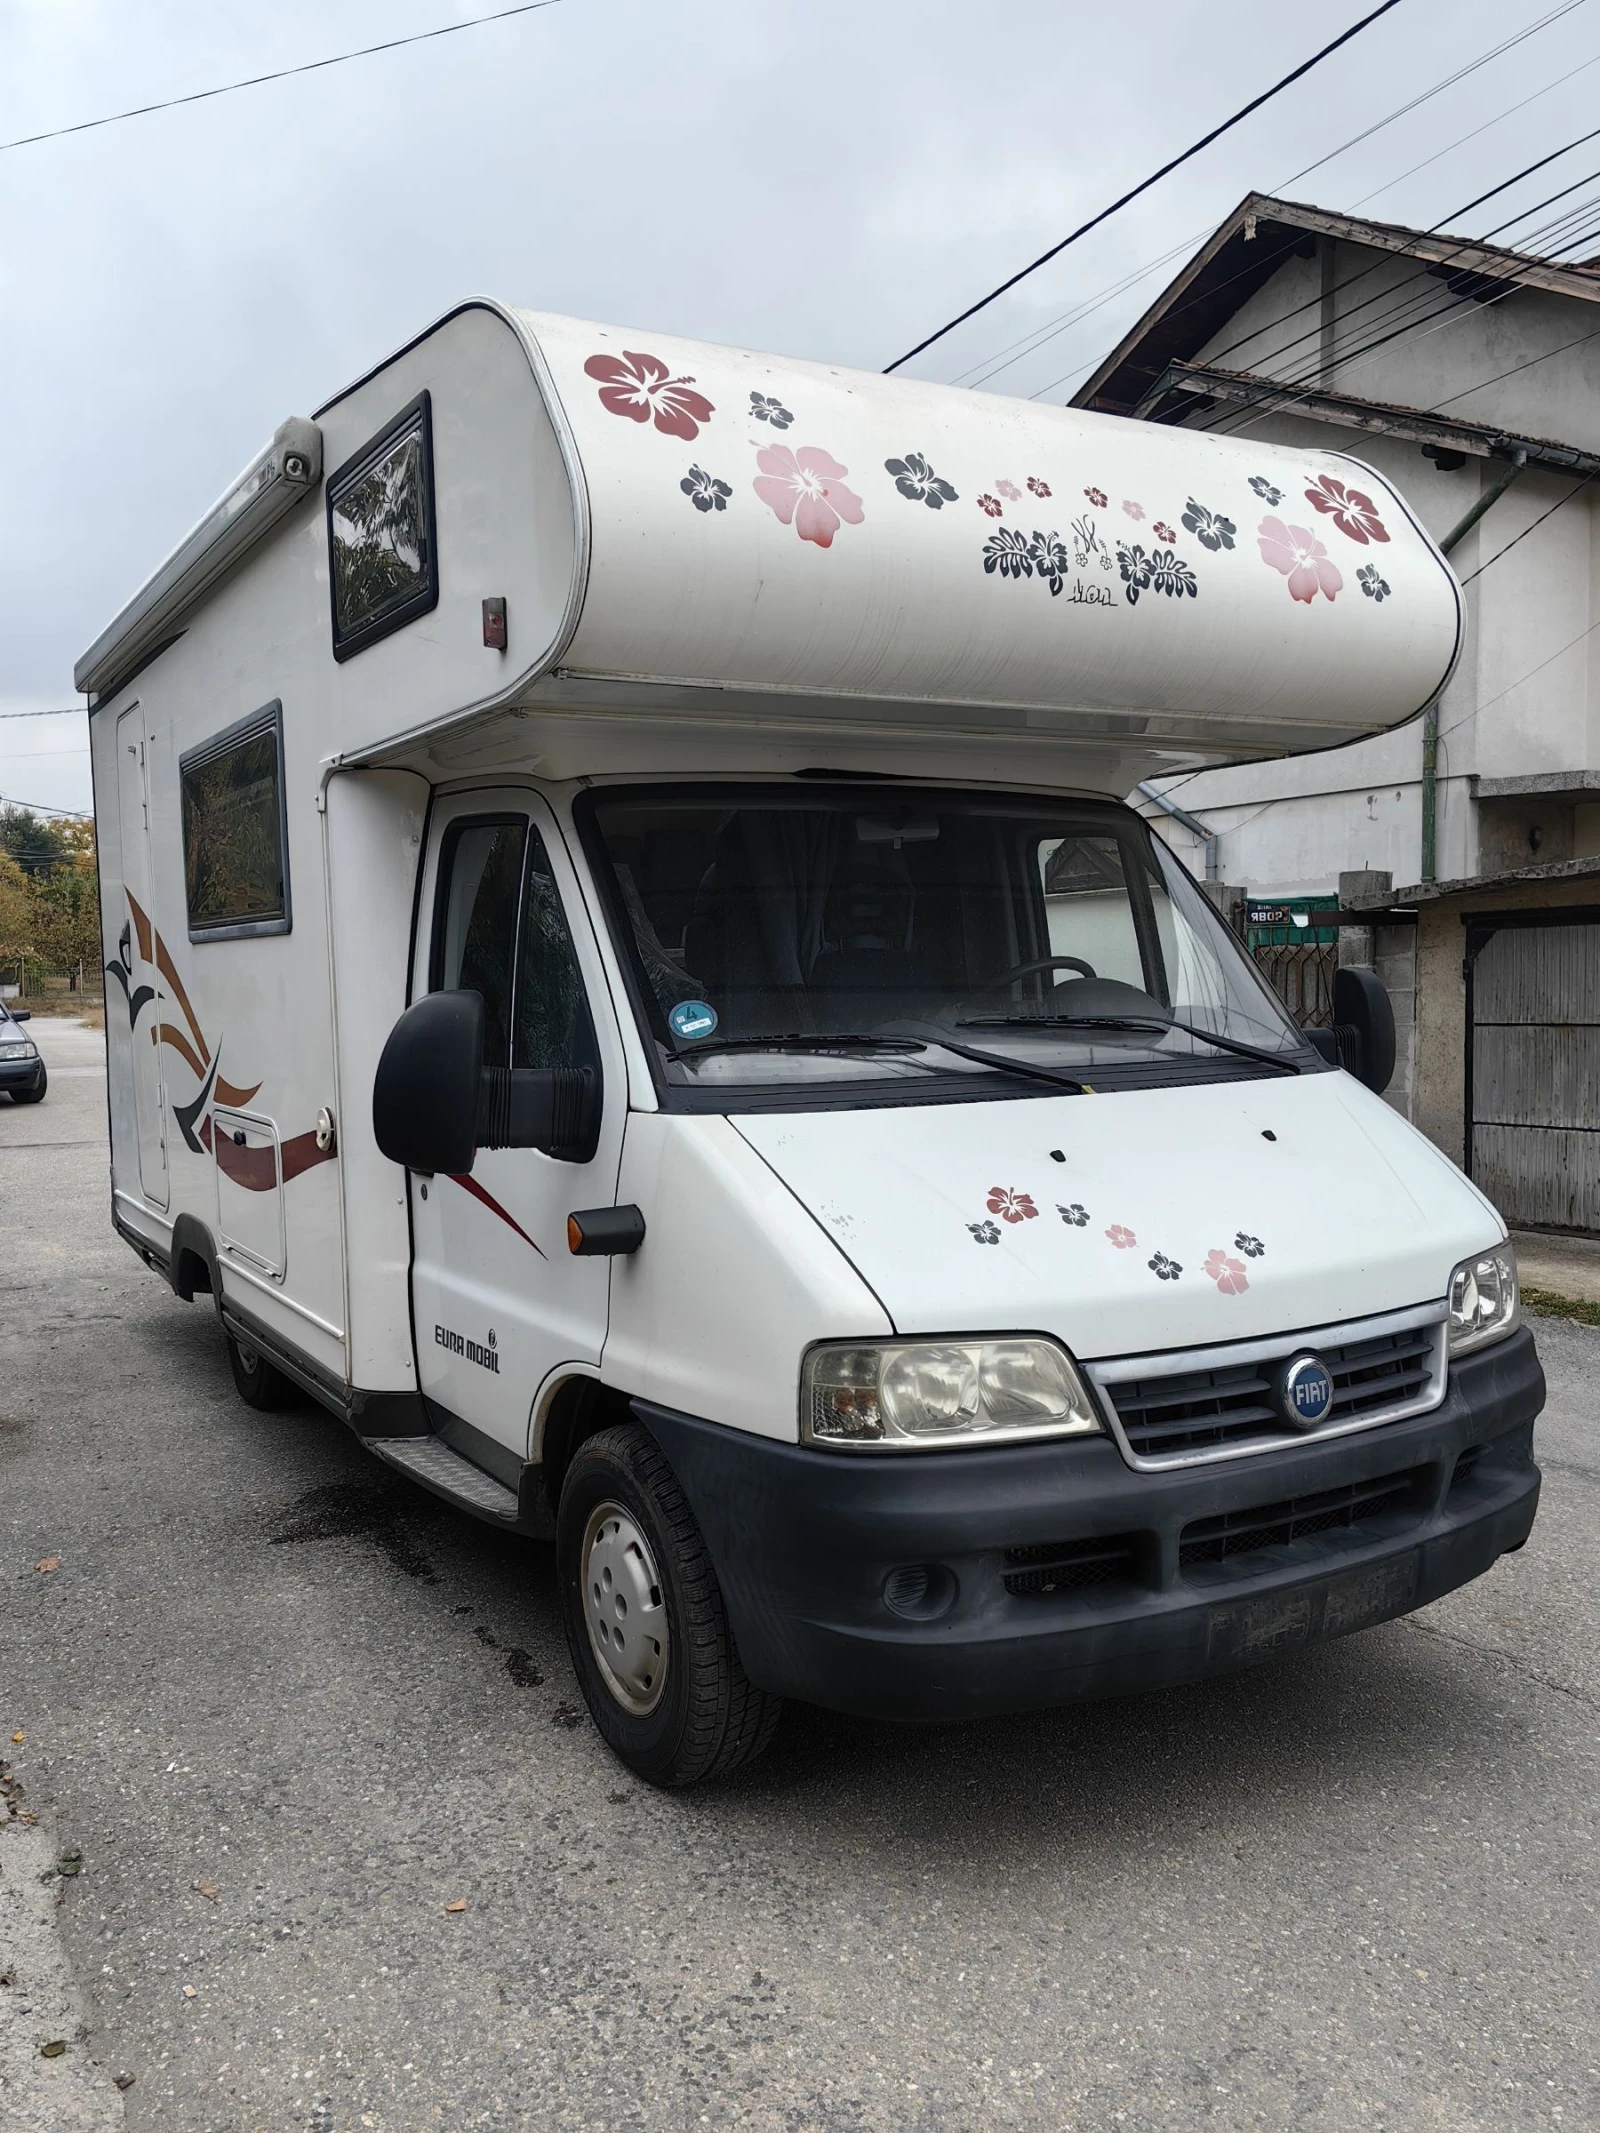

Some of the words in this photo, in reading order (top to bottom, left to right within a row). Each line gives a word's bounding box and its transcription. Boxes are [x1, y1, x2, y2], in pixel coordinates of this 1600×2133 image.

[686, 1006, 698, 1020] 4
[435, 1324, 465, 1357] EURA
[466, 1339, 500, 1375] MOBIL
[1295, 1380, 1327, 1406] FIAT
